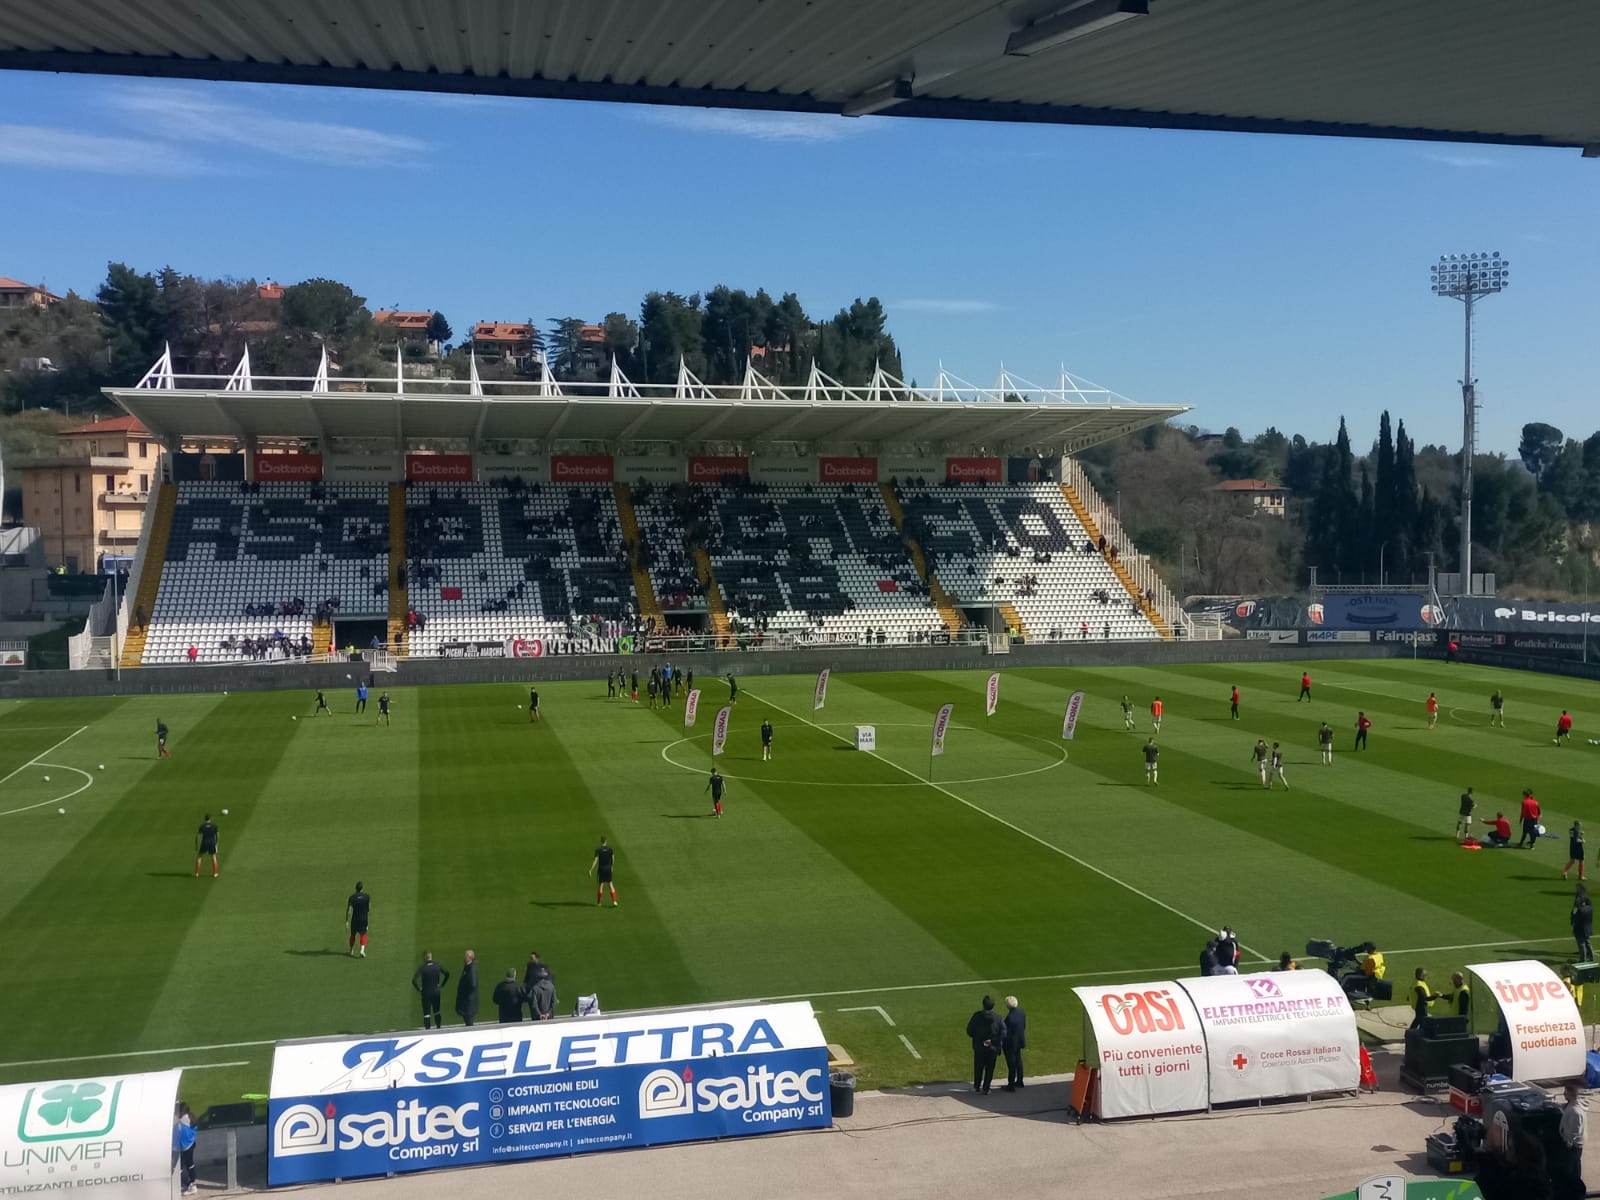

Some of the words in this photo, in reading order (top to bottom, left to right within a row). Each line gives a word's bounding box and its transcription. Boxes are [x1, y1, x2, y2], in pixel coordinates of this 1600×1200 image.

[259, 460, 317, 475] Battente
[412, 460, 467, 475] Battente
[557, 462, 608, 475] Battente
[824, 463, 873, 475] Battente
[950, 463, 997, 475] Battente
[547, 638, 616, 654] VETERANI
[1376, 630, 1438, 644] Fainplast
[688, 692, 697, 714] CONAD
[1067, 696, 1081, 722] CONAD
[717, 710, 727, 738] CONAD
[936, 708, 949, 738] CONAD
[1495, 979, 1565, 1011] tigre
[1101, 990, 1185, 1035] Oasi
[1203, 998, 1322, 1019] ELETTROMARCHE
[1212, 1017, 1247, 1026] IMPIANTI
[1248, 1013, 1285, 1024] ELETTRICI
[1293, 1009, 1344, 1019] TECNOLOGICI
[1516, 1021, 1576, 1035] Freschezza
[414, 1018, 784, 1083] SELETTRA
[1260, 1051, 1284, 1060] Croce
[1286, 1049, 1311, 1057] Rossa
[1312, 1045, 1341, 1055] Italiana
[1520, 1036, 1577, 1051] quotidiana
[1103, 1049, 1123, 1062] Più
[1127, 1044, 1202, 1060] conveniente
[1118, 1063, 1144, 1077] tutti
[1154, 1060, 1190, 1076] giorni
[507, 1082, 573, 1097] COSTRUZIONI
[576, 1079, 599, 1091] EDILI
[507, 1102, 552, 1116] IMPIANTI
[554, 1095, 620, 1112] TECNOLOGICI
[742, 1105, 804, 1123] Company
[807, 1102, 823, 1116] srl
[508, 1122, 543, 1135] SERVIZI
[546, 1120, 564, 1130] PER
[567, 1114, 616, 1128] L'ENERGIA
[389, 1141, 458, 1161] Company
[463, 1138, 479, 1152] srl
[493, 1140, 569, 1154] info@saiteccompany.it
[577, 1133, 632, 1145] saiteccompany.it
[4, 1140, 123, 1167] UNIMER
[77, 1174, 144, 1186] ECOLOGICI
